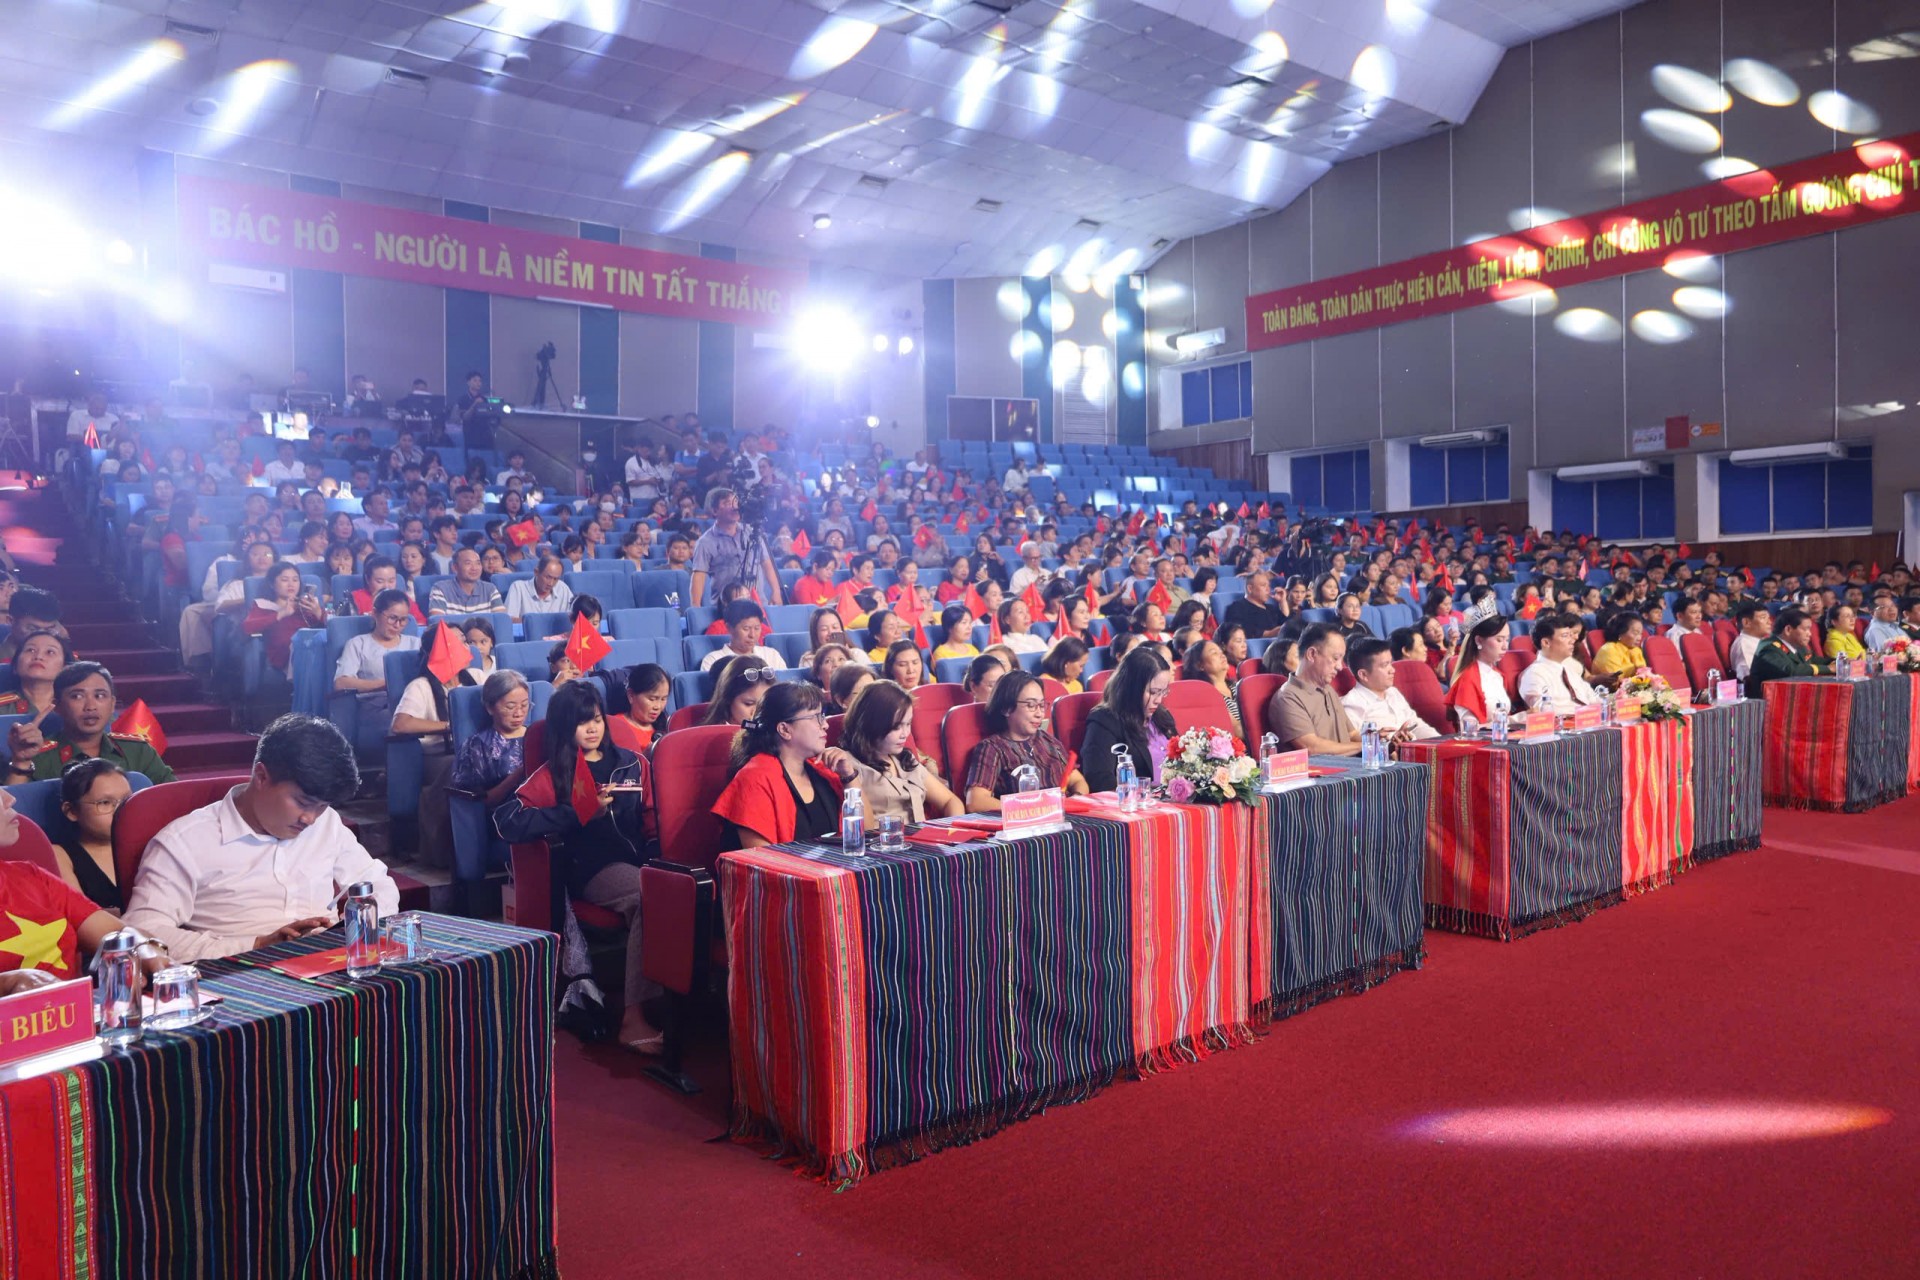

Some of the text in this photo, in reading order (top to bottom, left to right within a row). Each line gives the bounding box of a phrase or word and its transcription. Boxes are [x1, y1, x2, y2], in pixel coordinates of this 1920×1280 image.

[209, 203, 281, 245] BÁC
[294, 210, 339, 253] HỒ
[375, 231, 467, 272] NGƯỜI
[479, 243, 513, 280] LÀ
[525, 248, 594, 291] NIỀM
[603, 266, 644, 298] TIN
[652, 267, 698, 304] TẤT
[706, 275, 781, 314] THẮNG
[1263, 307, 1287, 333] TOÀN
[1290, 297, 1319, 327] ĐẢNG,
[1321, 290, 1348, 321] TOÀN
[1351, 285, 1373, 315] DÂN
[1375, 279, 1404, 312] THỰC
[1407, 271, 1434, 308] HIỆN
[1437, 261, 1464, 299] CẦN,
[1467, 256, 1503, 293] KIỆM,
[1505, 246, 1541, 282] LIÊM,
[1545, 235, 1589, 270] CHÍNH,
[1593, 230, 1617, 262] CHÍ
[1619, 218, 1660, 254] CÔNG
[1663, 208, 1683, 246] VÔ
[1688, 203, 1709, 240] TƯ
[1714, 200, 1755, 233] THEO
[1760, 180, 1797, 227] TẤM
[1802, 174, 1861, 215] GƯƠNG
[12, 1001, 76, 1041] BIỂU
